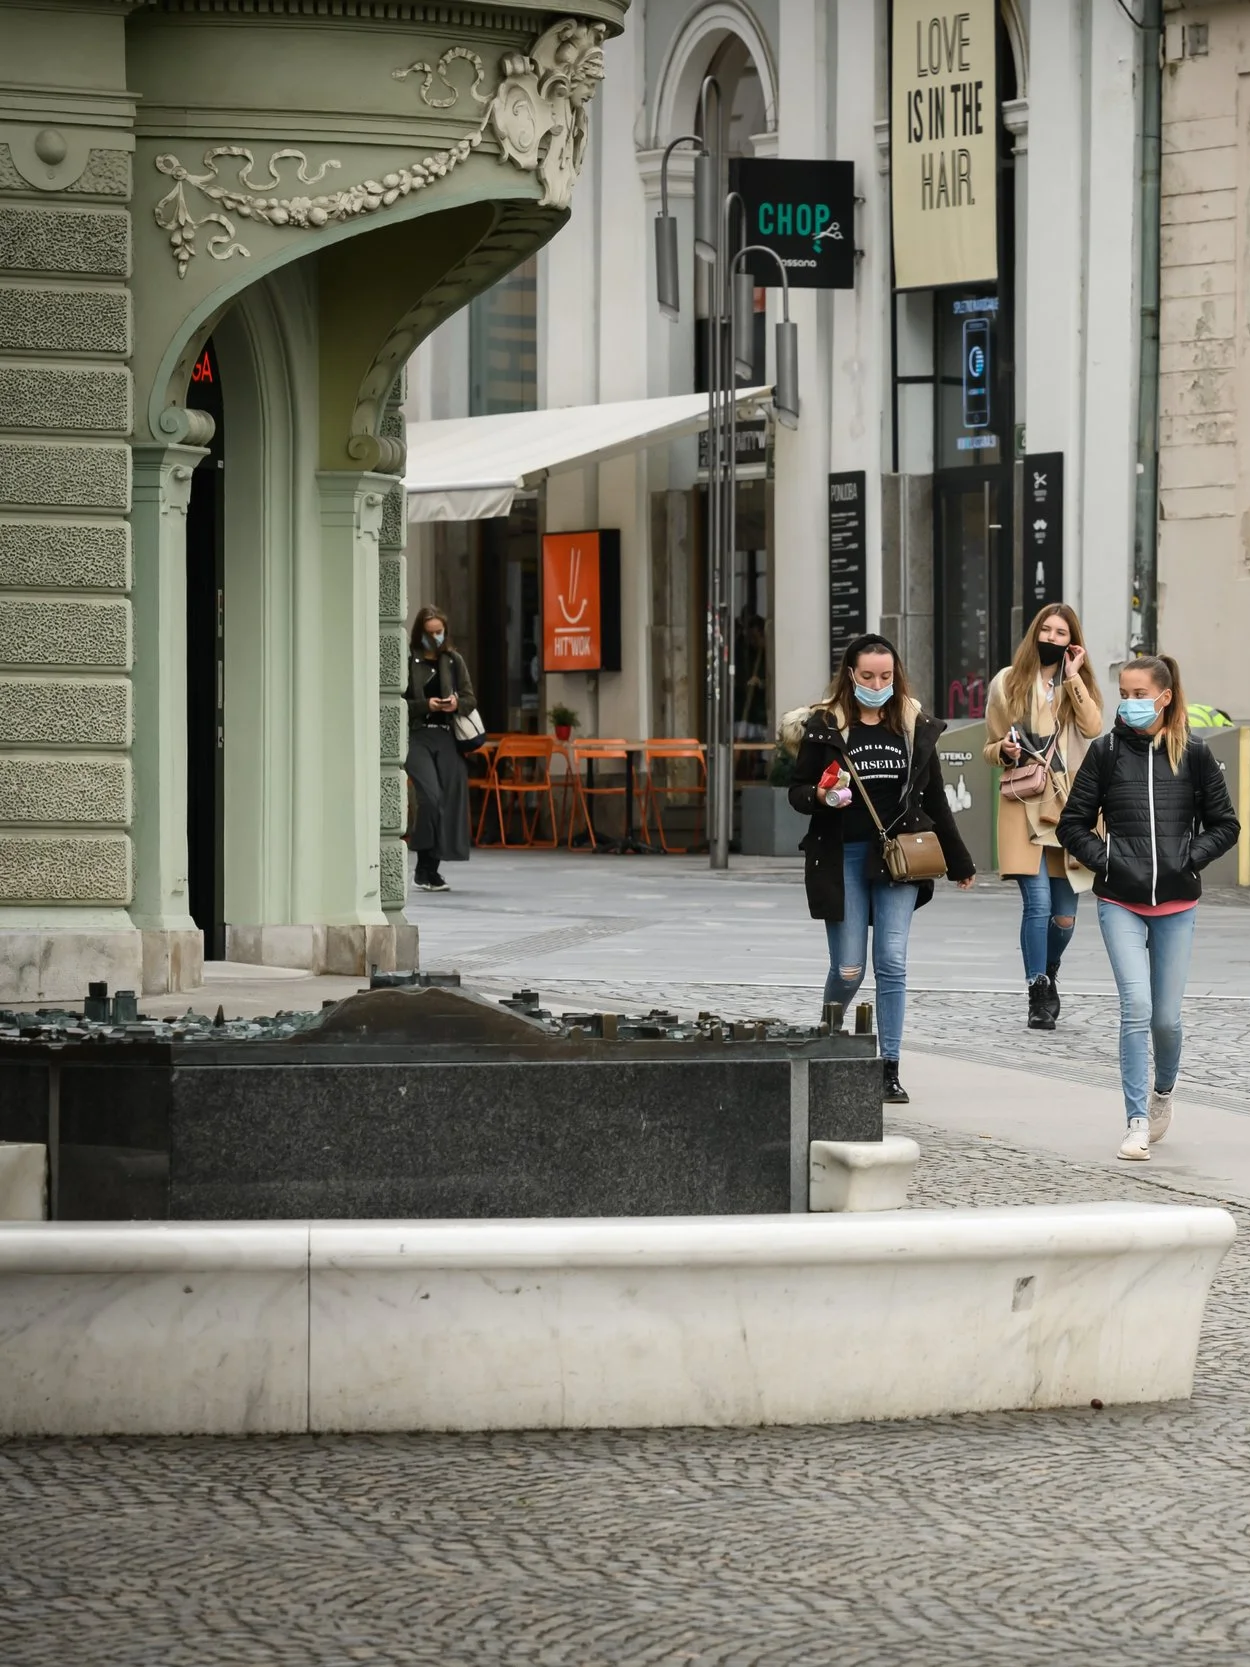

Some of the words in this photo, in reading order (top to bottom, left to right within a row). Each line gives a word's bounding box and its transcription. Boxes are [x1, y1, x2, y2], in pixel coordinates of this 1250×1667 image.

[916, 13, 970, 77] LOVE
[907, 89, 923, 143] IS
[929, 85, 945, 140] IN
[950, 81, 983, 137] THE
[921, 148, 975, 211] HAIR.
[758, 202, 831, 237] CHOP
[853, 758, 907, 771] ARSEILLE
[885, 745, 902, 755] MODE
[940, 752, 973, 760] STEKLO
